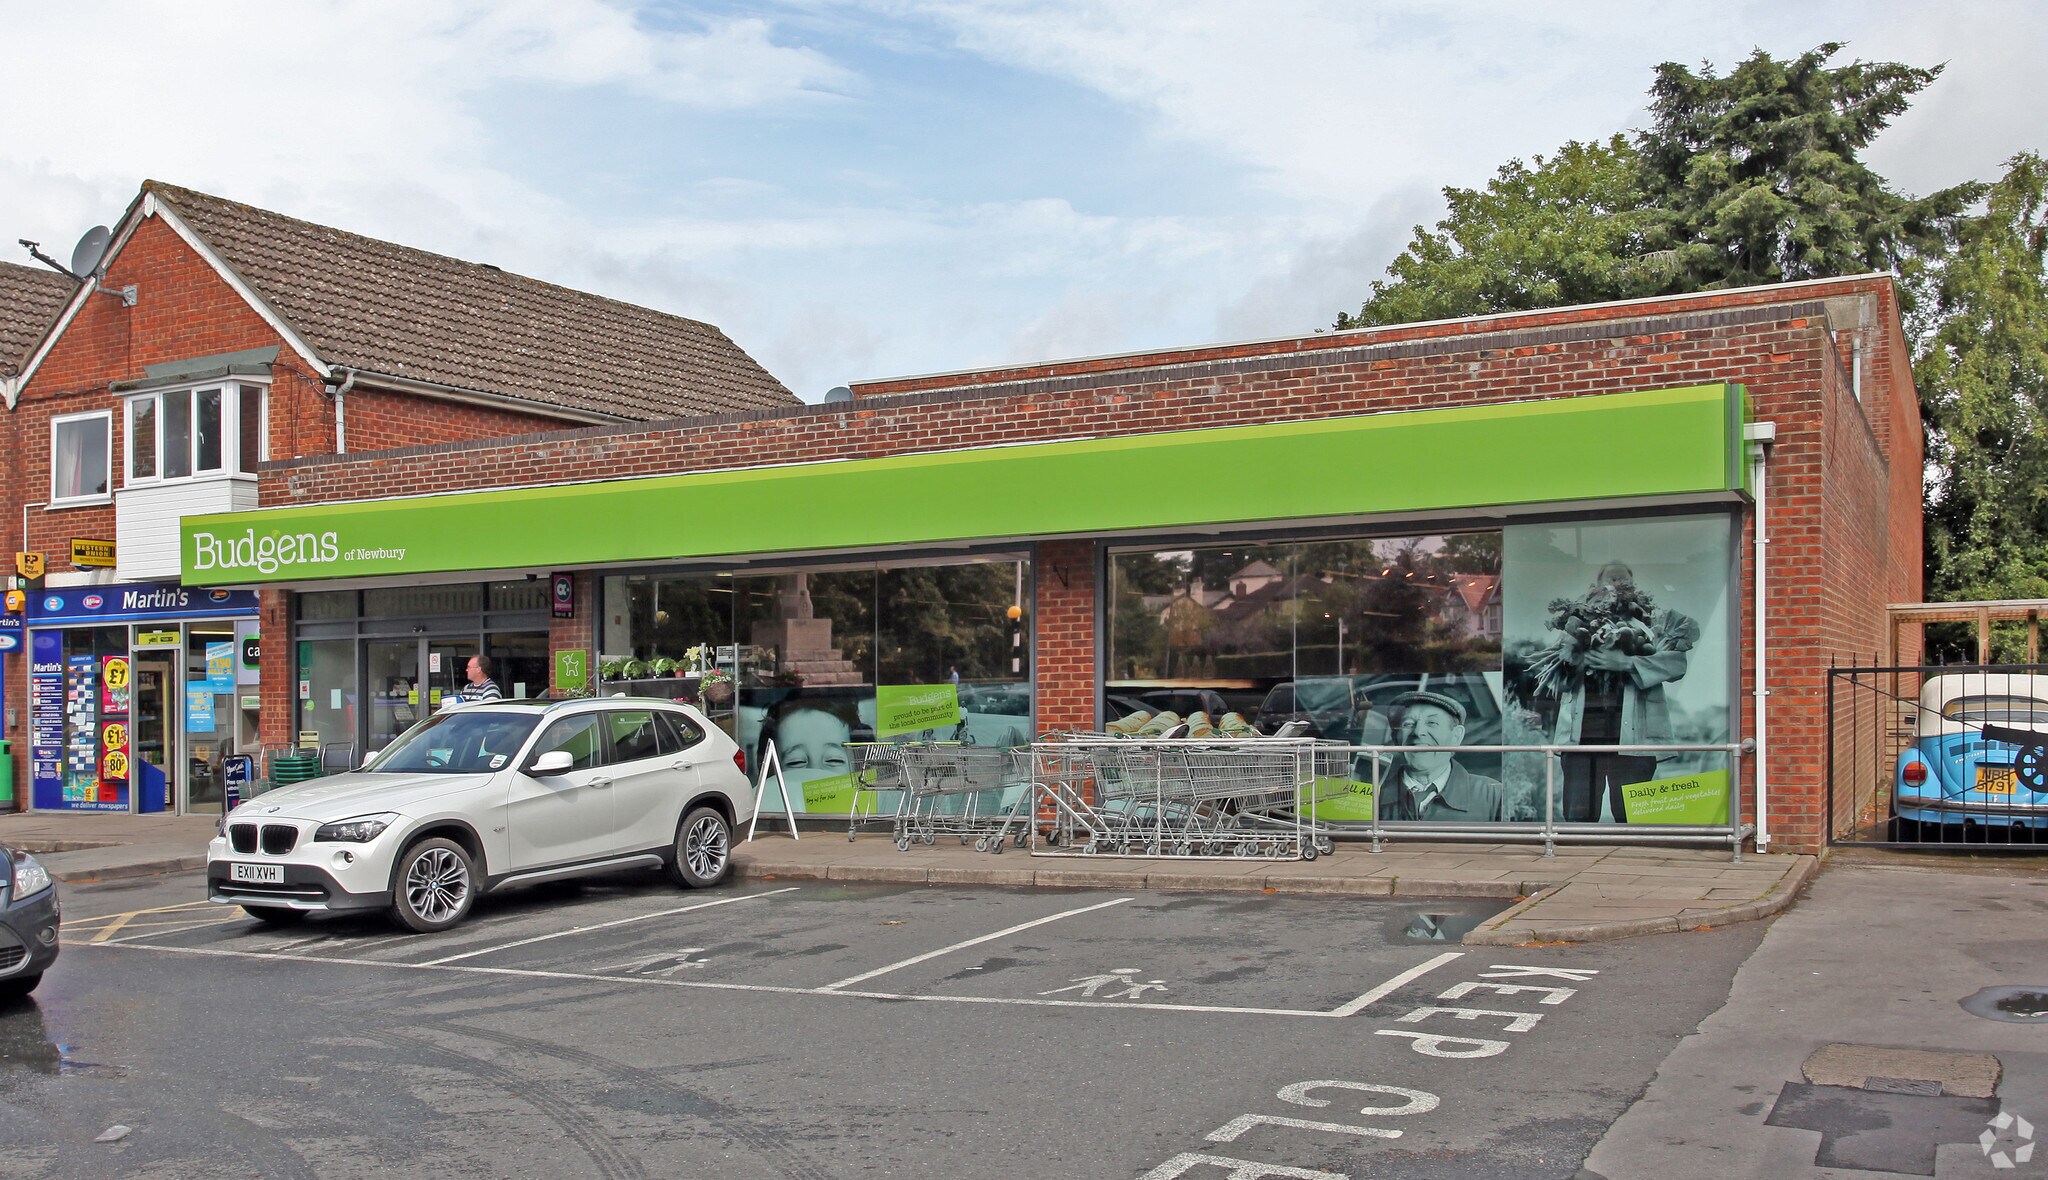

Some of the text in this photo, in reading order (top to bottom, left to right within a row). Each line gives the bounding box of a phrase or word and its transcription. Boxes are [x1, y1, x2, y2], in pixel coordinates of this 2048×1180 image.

[193, 528, 406, 574] Budgens of Newbury
[122, 588, 189, 610] Martin's
[247, 646, 260, 657] ca
[33, 662, 62, 672] Martin's
[109, 668, 126, 685] £1
[909, 689, 952, 706] Budgens
[893, 710, 913, 721] proud
[930, 705, 945, 713] part
[901, 719, 917, 727] local
[917, 711, 954, 724] community
[108, 730, 120, 744] £1
[1629, 780, 1700, 798] Daily & fresh
[1650, 797, 1668, 806] fruit
[1669, 794, 1683, 802] and
[1685, 789, 1721, 801] vegetables
[1632, 802, 1685, 816] delivered daily
[257, 867, 276, 880] XVH
[1374, 965, 1600, 1059] KEEP
[1134, 1079, 1441, 1180] CLE
